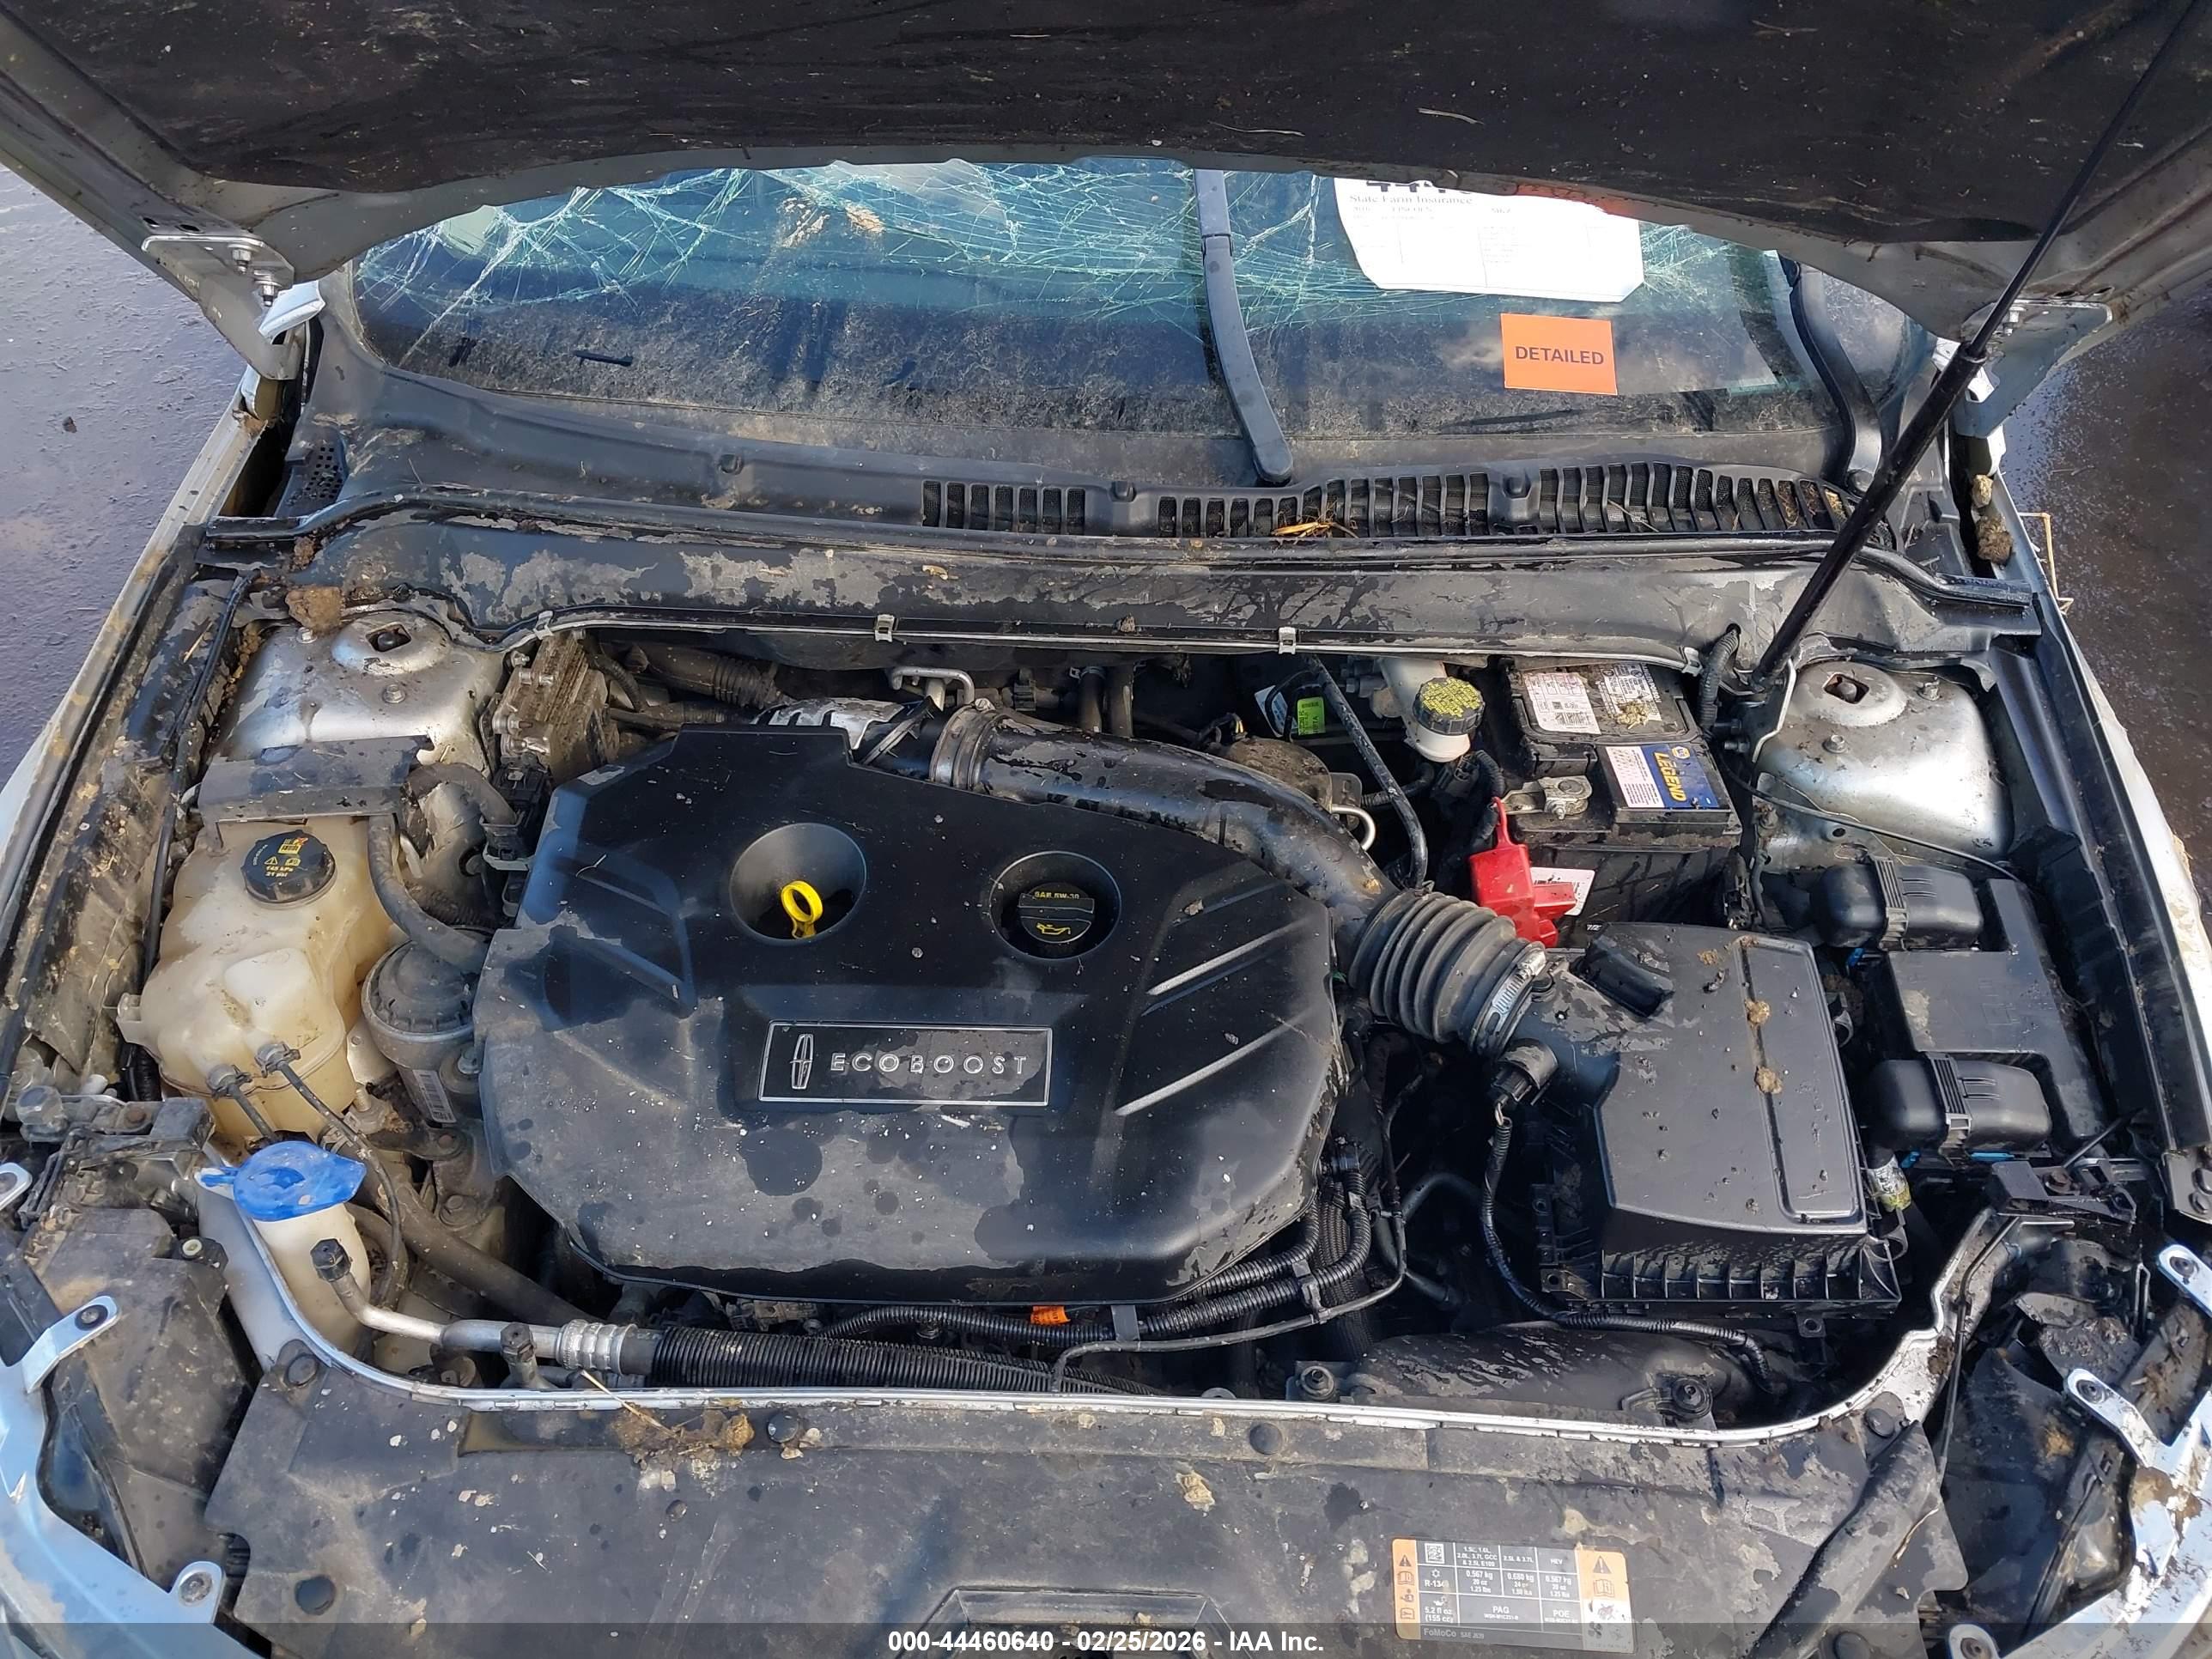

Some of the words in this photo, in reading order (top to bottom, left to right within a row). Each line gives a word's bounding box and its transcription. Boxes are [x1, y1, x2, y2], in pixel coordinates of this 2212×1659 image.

[1417, 196, 1473, 204] Insurance
[1516, 345, 1604, 366] DETAILED
[1654, 751, 1686, 801] LEGEND
[830, 1052, 1027, 1075] ECOBOOST
[1492, 1605, 1510, 1614] PAG
[1553, 1609, 1571, 1619] POE
[1425, 1613, 1441, 1622] (155
[1423, 1627, 1457, 1638] FoMoCo
